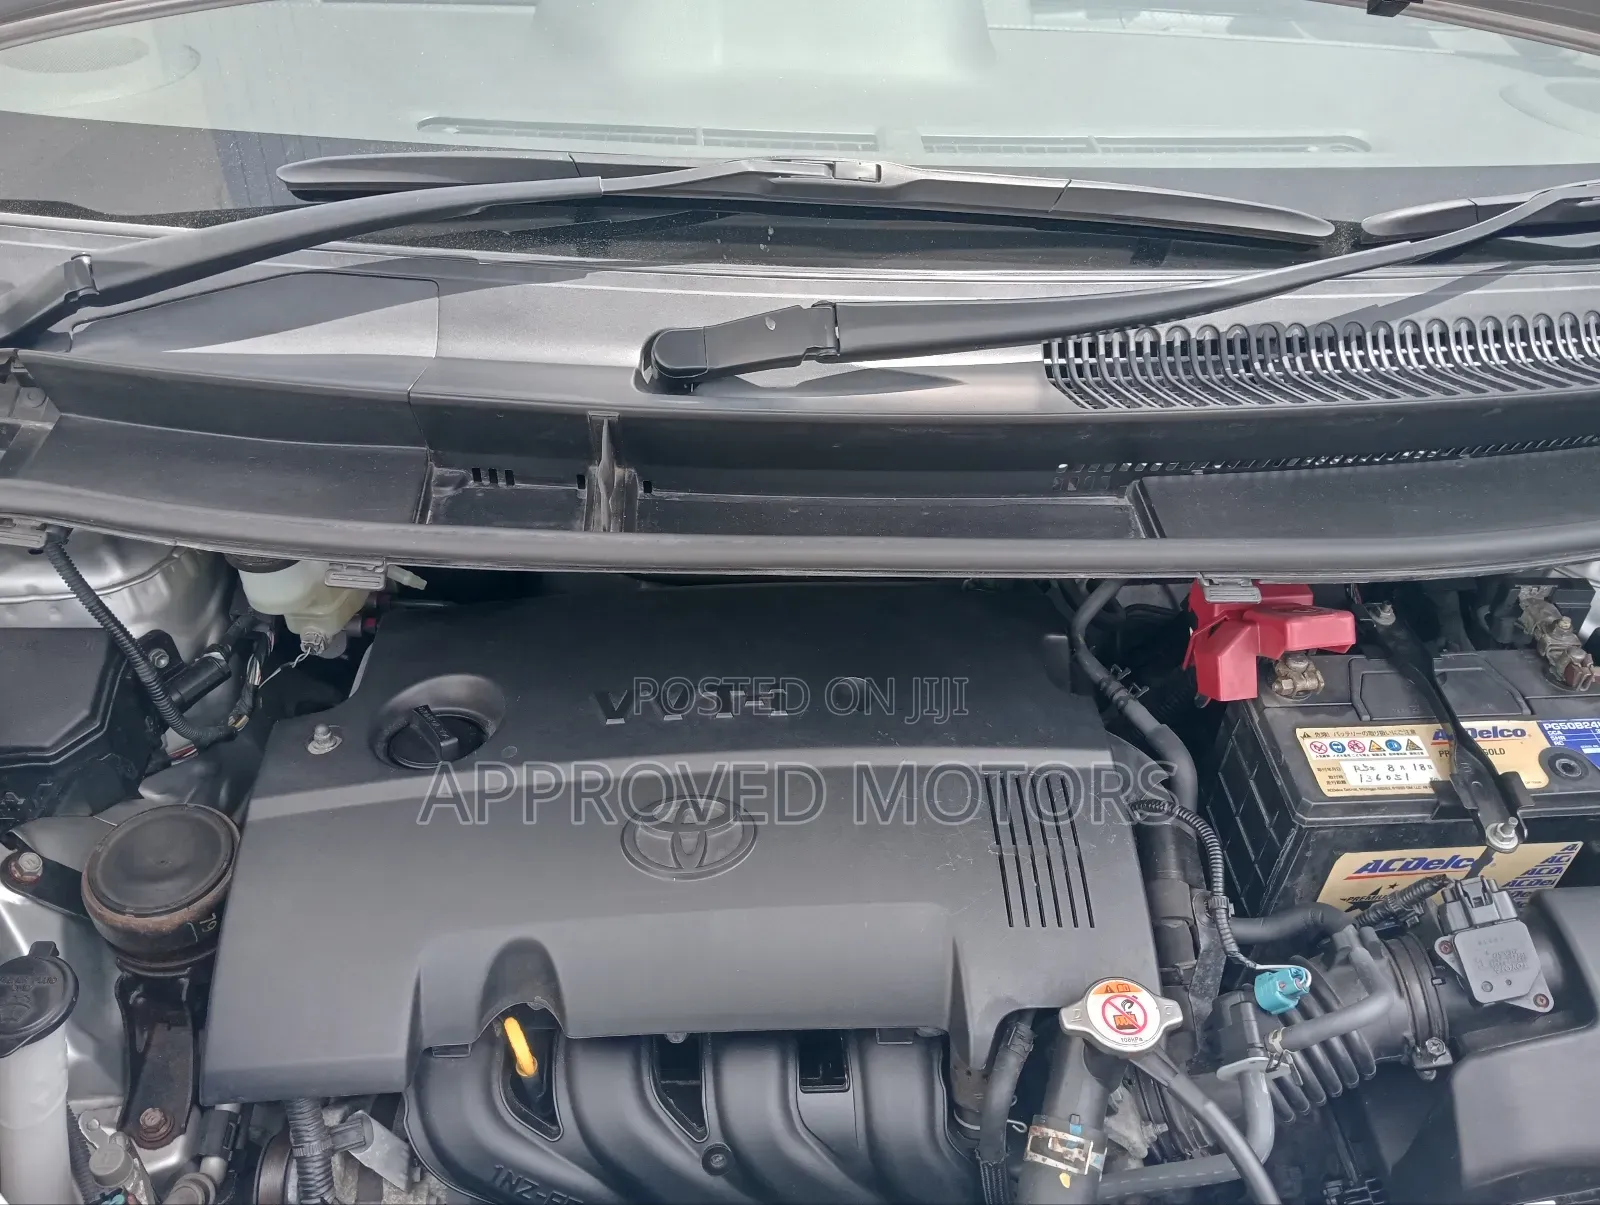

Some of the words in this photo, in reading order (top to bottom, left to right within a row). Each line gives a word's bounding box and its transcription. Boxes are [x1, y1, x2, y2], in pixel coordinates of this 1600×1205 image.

[1433, 726, 1526, 740] ADelco
[1543, 721, 1600, 731] PG50B24
[1353, 855, 1494, 874] ACDelc
